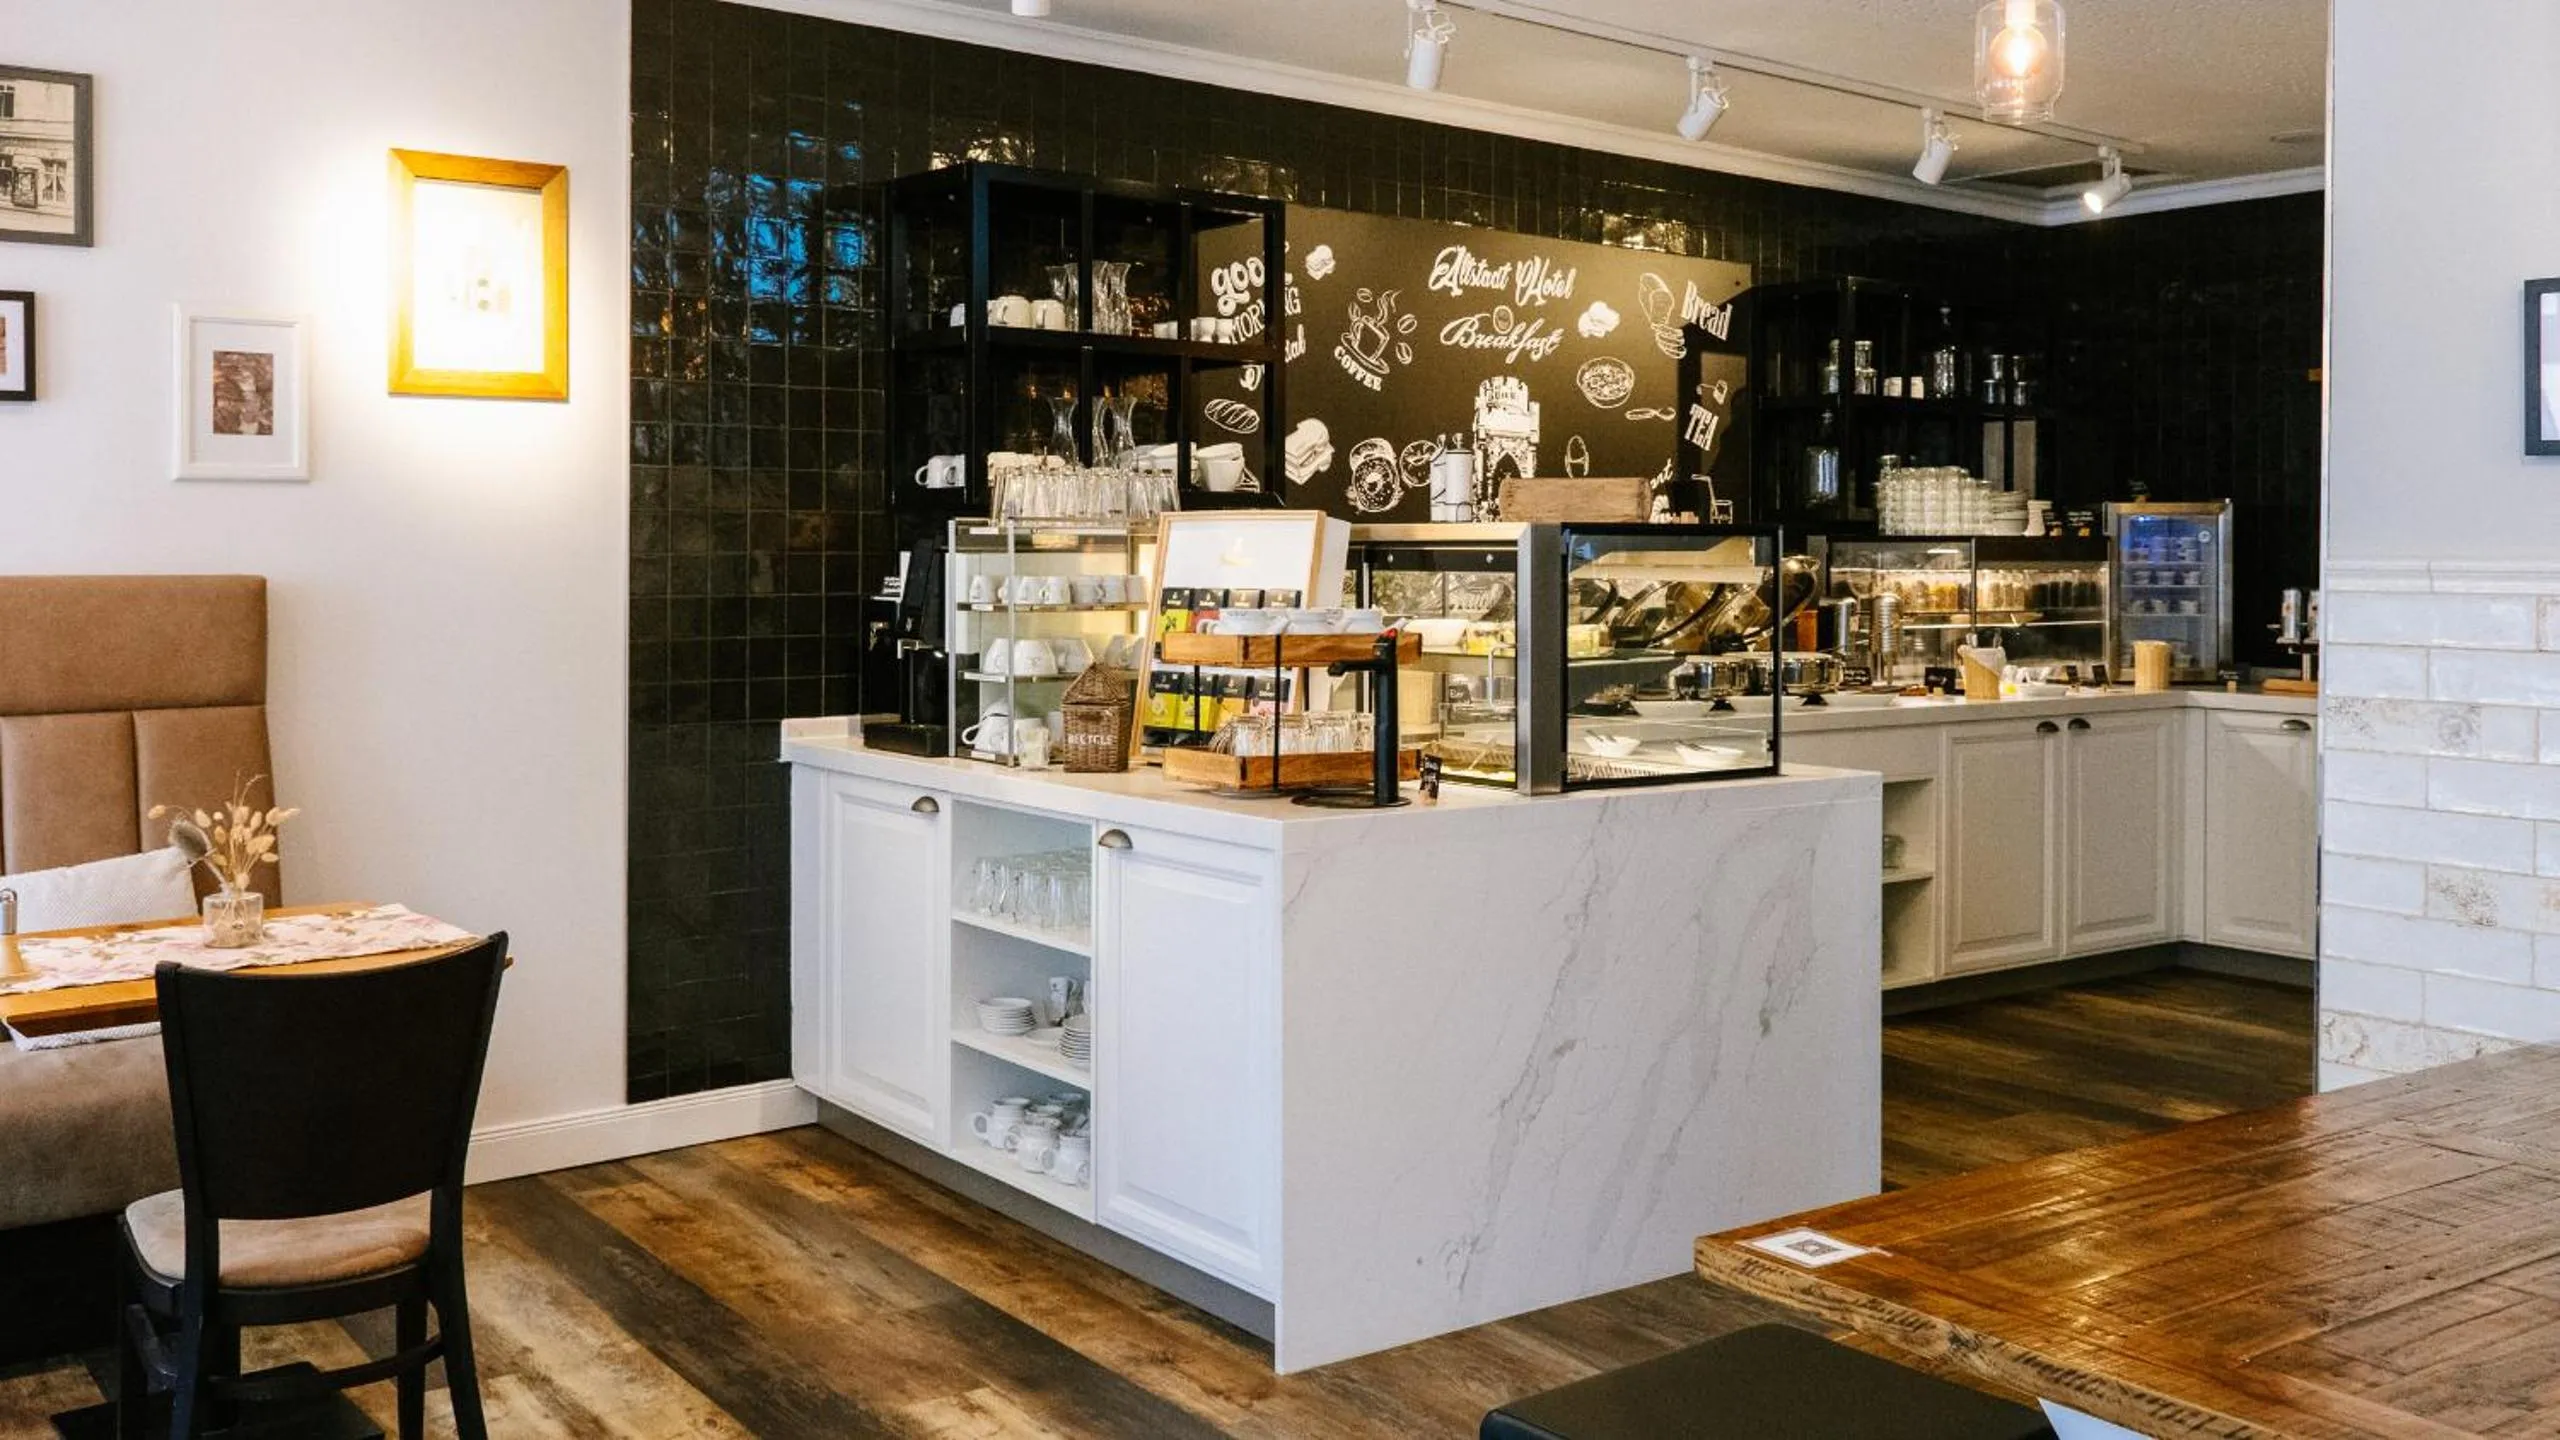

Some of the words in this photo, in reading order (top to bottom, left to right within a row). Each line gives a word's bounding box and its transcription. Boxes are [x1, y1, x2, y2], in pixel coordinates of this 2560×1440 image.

[1516, 255, 1577, 307] Hotel
[1681, 279, 1734, 341] Bread
[1440, 313, 1564, 364] Breakfast
[1334, 346, 1382, 391] COFFEE
[1684, 403, 1719, 451] TEA
